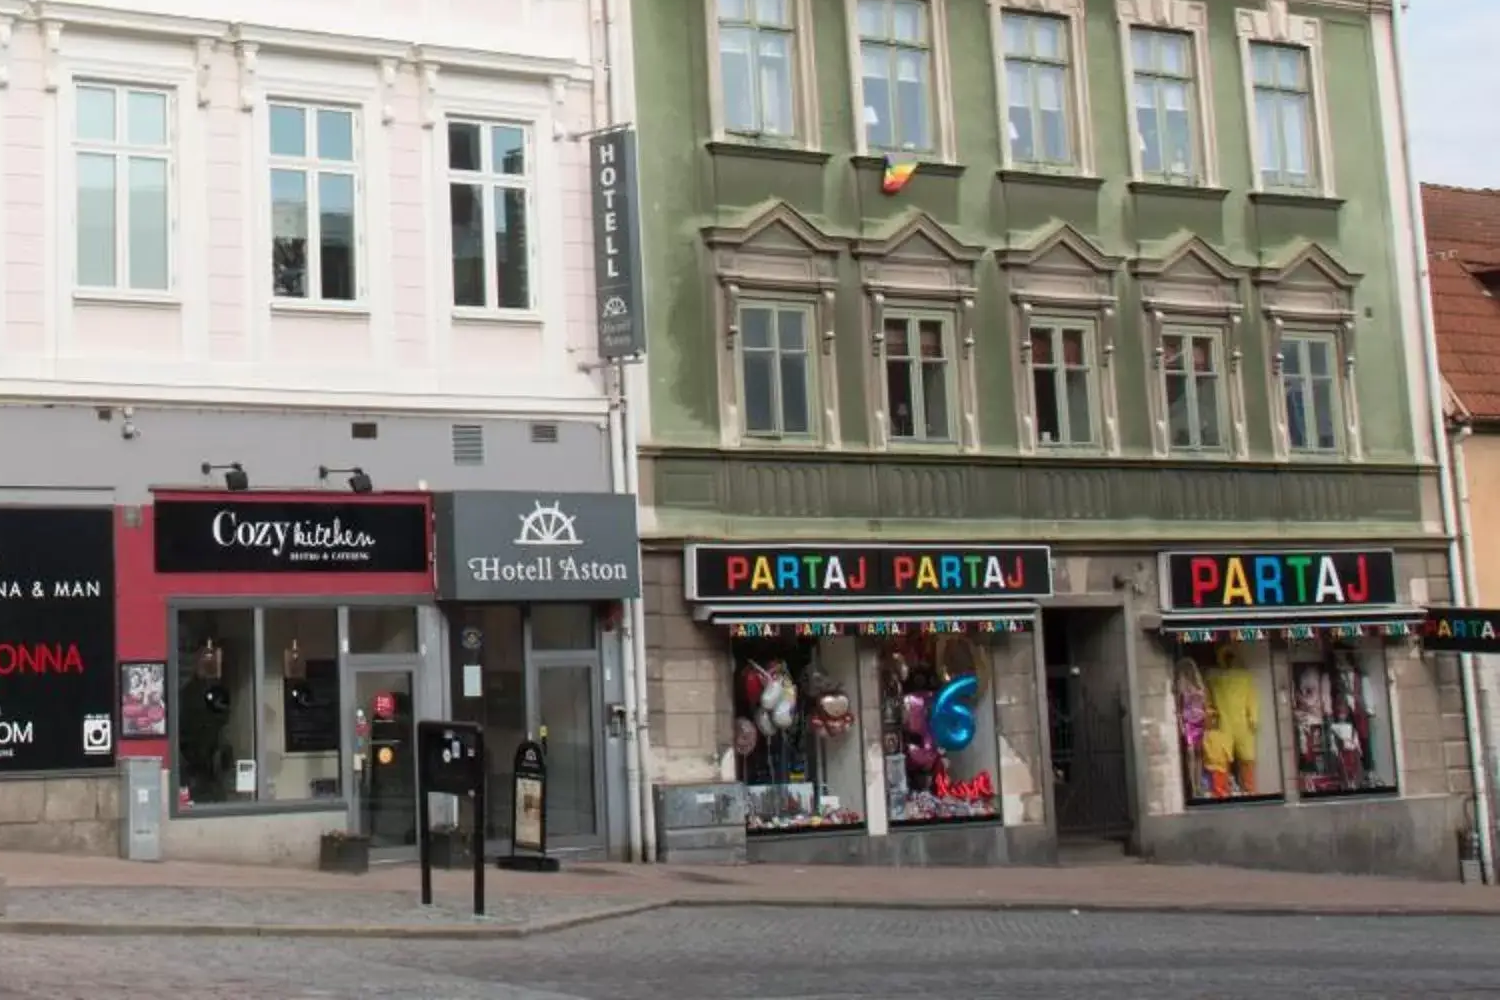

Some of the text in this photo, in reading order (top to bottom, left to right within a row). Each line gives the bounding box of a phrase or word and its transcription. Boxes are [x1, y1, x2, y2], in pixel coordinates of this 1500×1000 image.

[599, 143, 619, 277] HOTELL
[212, 509, 376, 557] Cozy kitchen
[32, 581, 45, 598] &
[53, 579, 101, 598] MAN
[467, 554, 628, 582] Hotell Aston
[726, 554, 1025, 590] PARTAJ PARTAJ
[1190, 553, 1369, 608] PARTAJ
